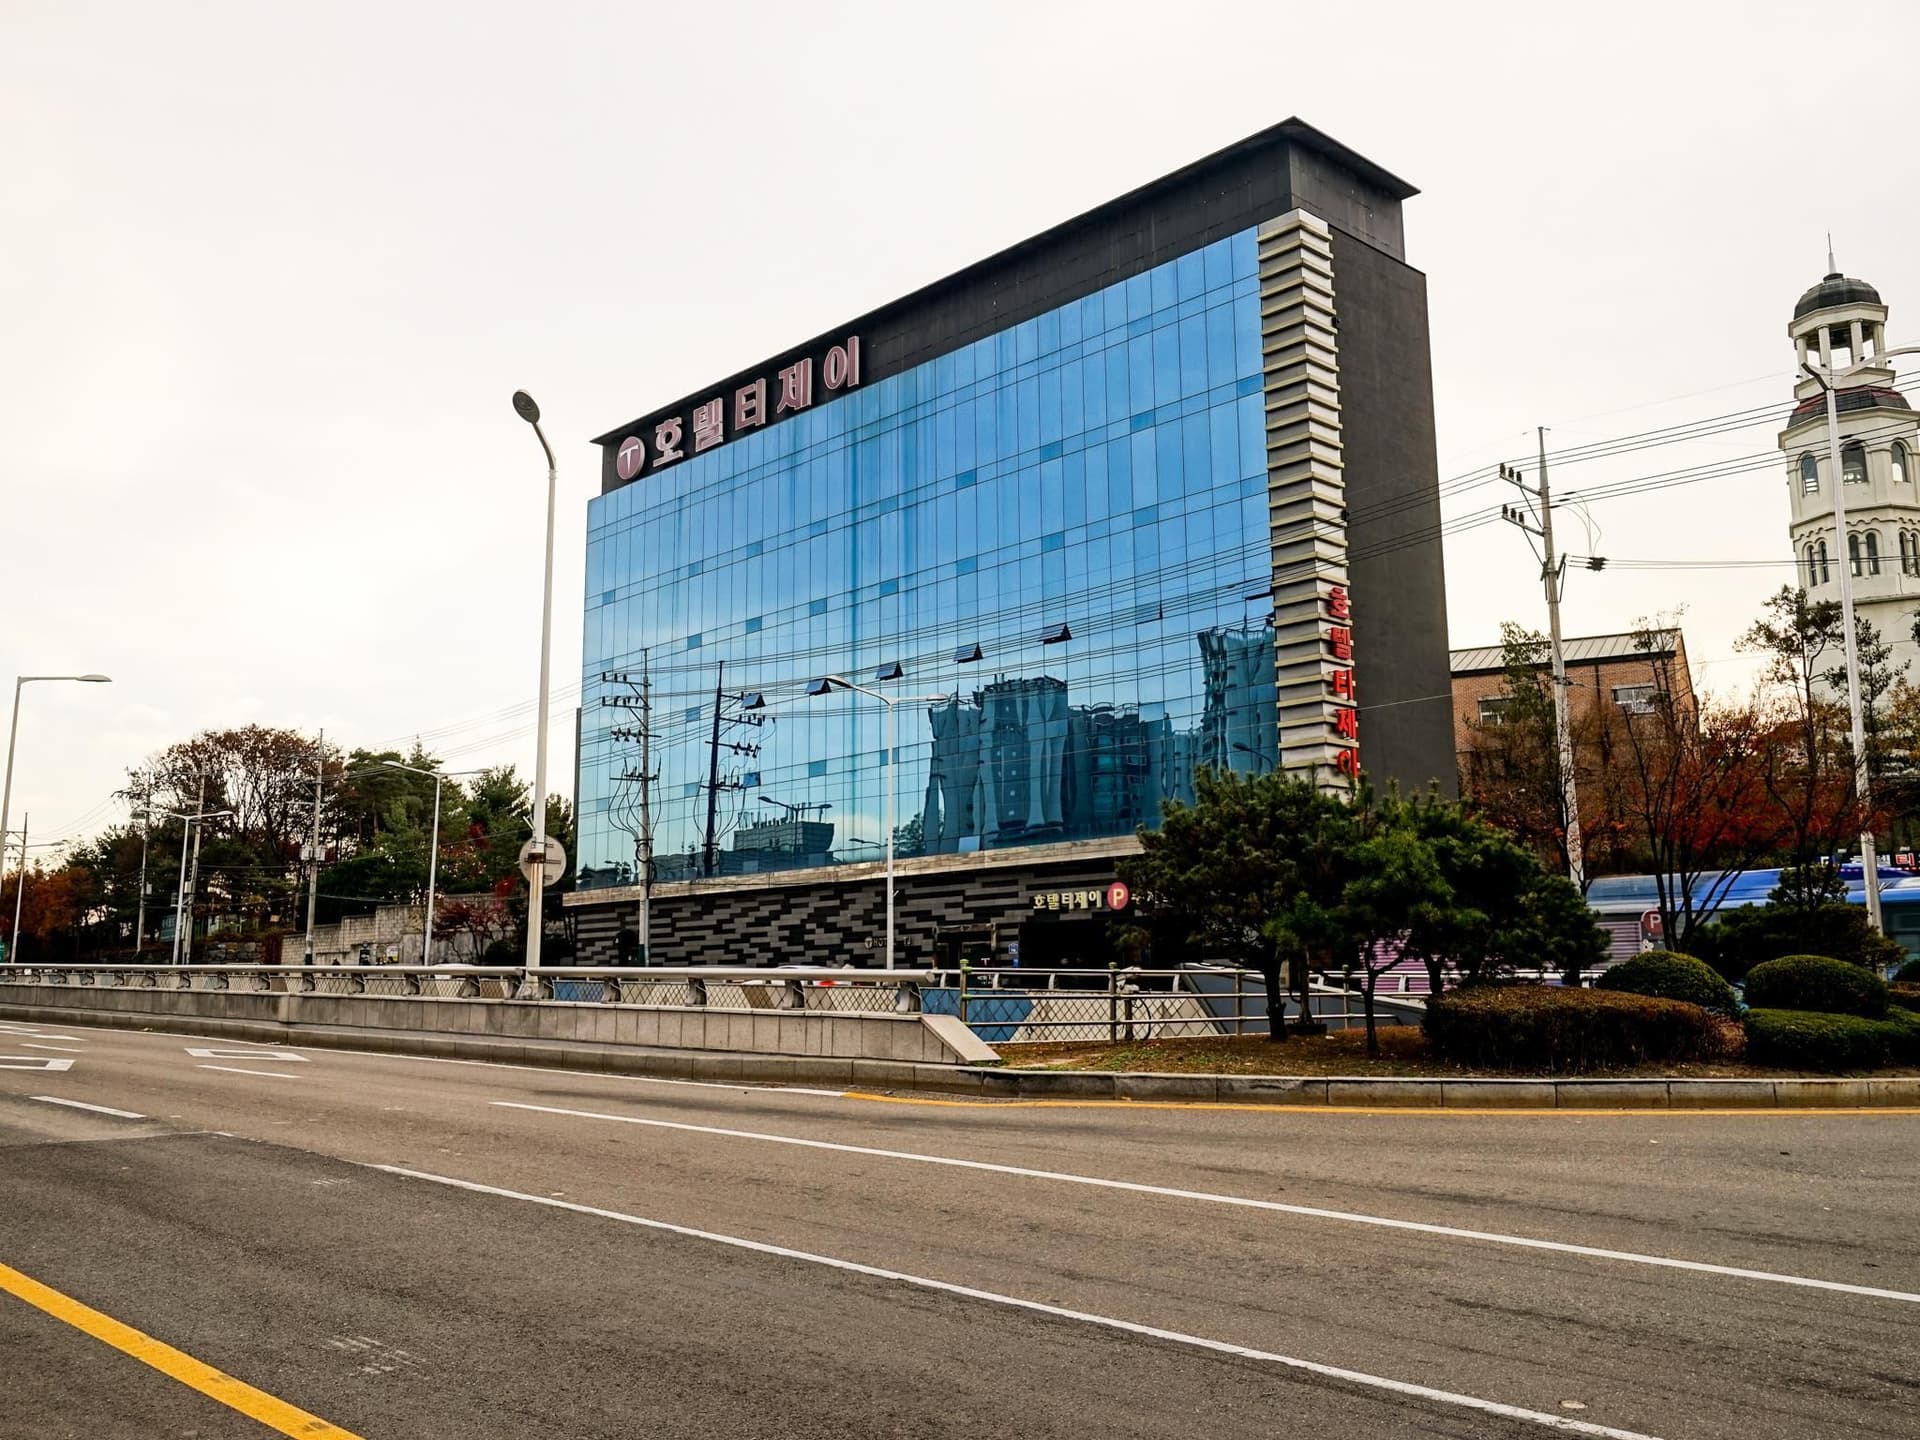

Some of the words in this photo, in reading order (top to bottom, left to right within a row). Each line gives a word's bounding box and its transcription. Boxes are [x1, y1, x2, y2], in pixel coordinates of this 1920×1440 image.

[652, 335, 860, 467] 호텔티제이
[1328, 586, 1359, 778] 호텔티제이
[1033, 890, 1103, 911] 호텔티제이
[1649, 913, 1662, 929] P
